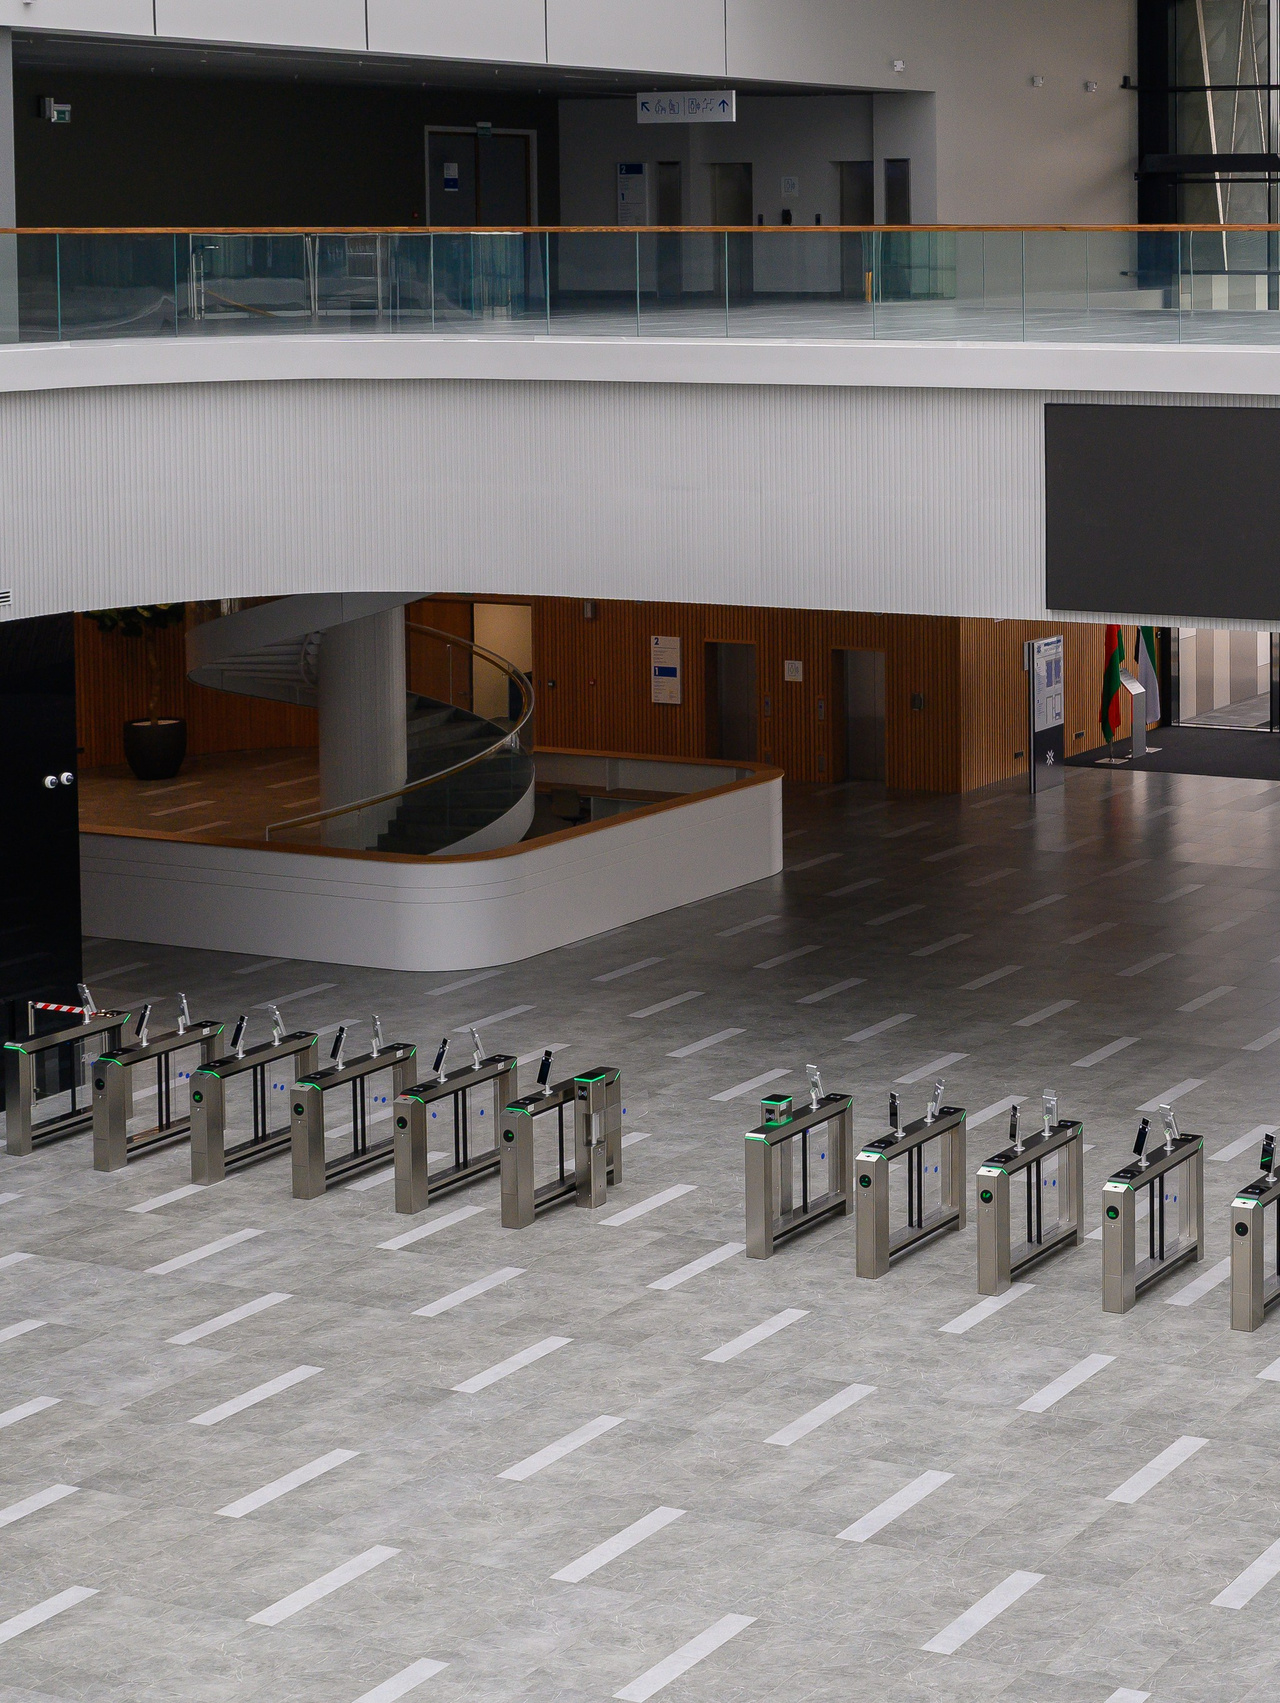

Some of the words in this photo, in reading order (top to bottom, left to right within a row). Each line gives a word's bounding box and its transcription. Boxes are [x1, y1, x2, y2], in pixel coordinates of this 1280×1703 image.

[621, 165, 626, 174] 2
[654, 637, 659, 646] 2
[655, 667, 659, 675] 1
